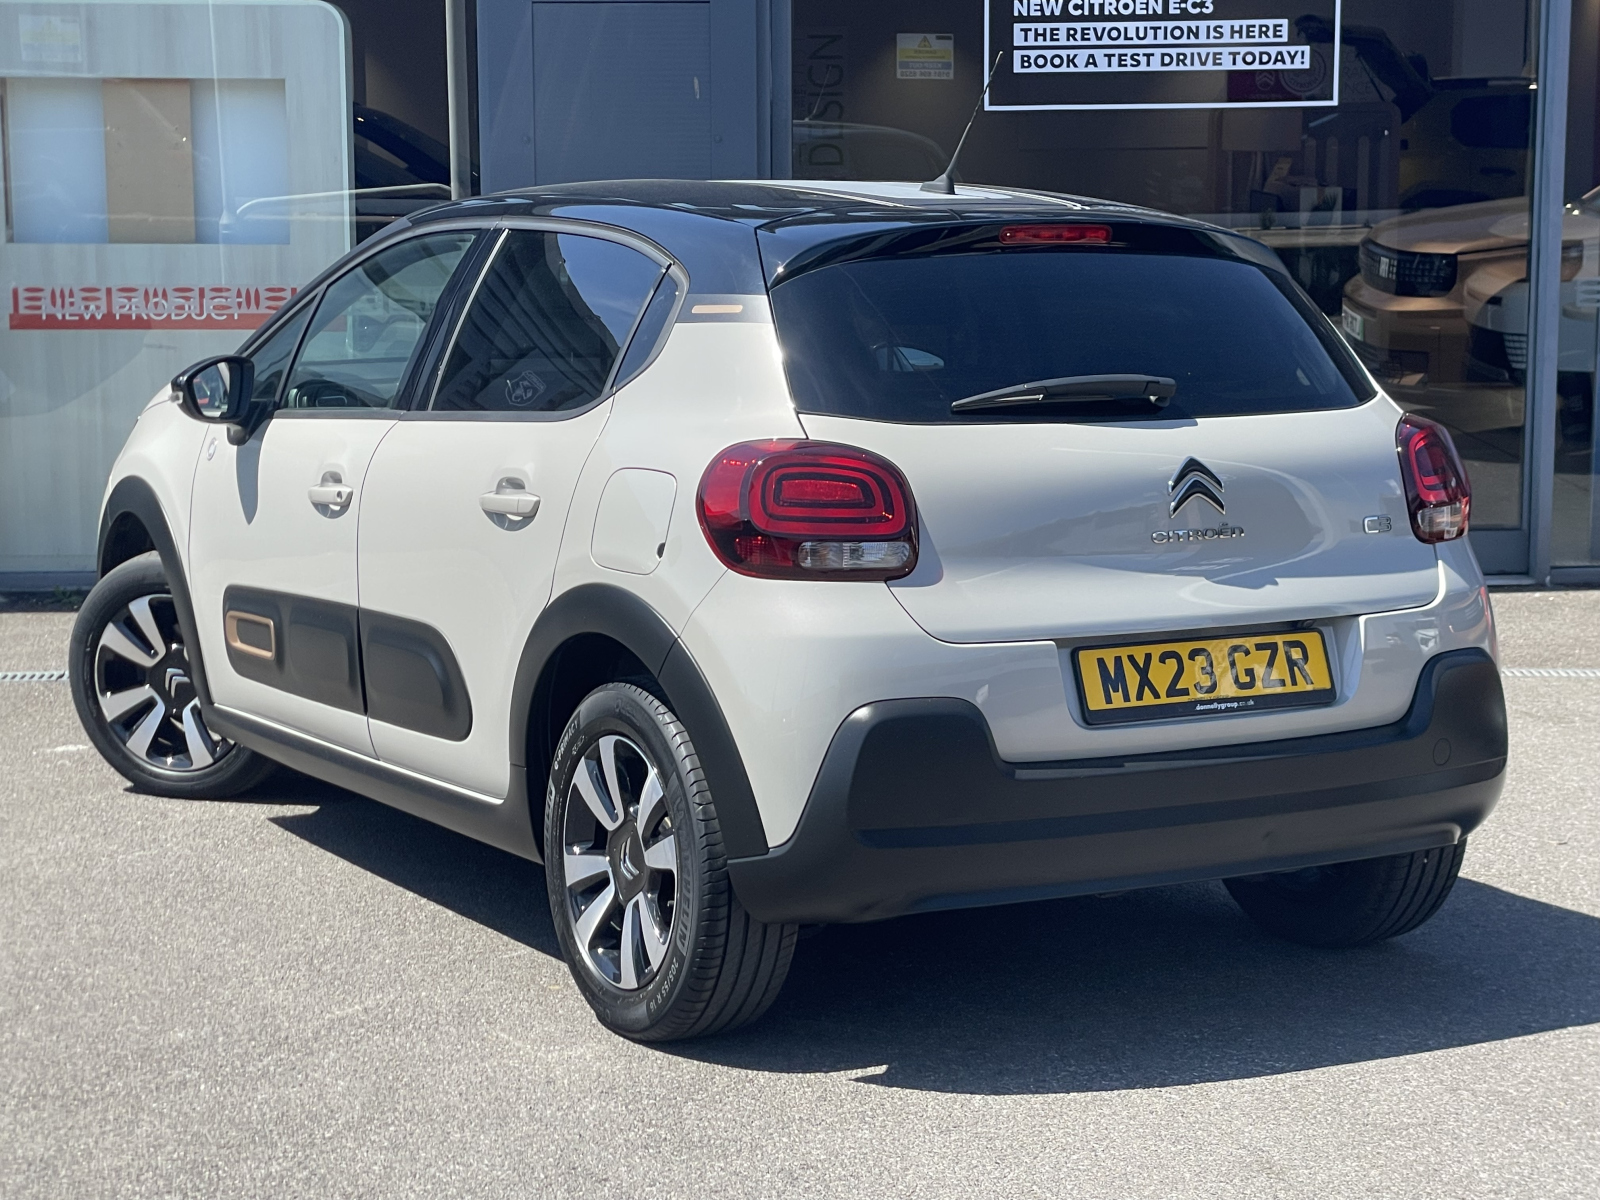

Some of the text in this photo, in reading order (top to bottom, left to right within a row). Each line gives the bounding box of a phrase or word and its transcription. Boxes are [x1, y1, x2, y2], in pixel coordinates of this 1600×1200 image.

[1013, 0, 1063, 16] NEW
[1020, 23, 1284, 42] THE REVOLUTION IS HERE
[1020, 50, 1306, 70] BOOK A TEST DRIVE TODAY!
[41, 297, 244, 321] NEW PRODUCT
[1362, 514, 1392, 534] C3
[1096, 639, 1315, 705] MX23 GZR
